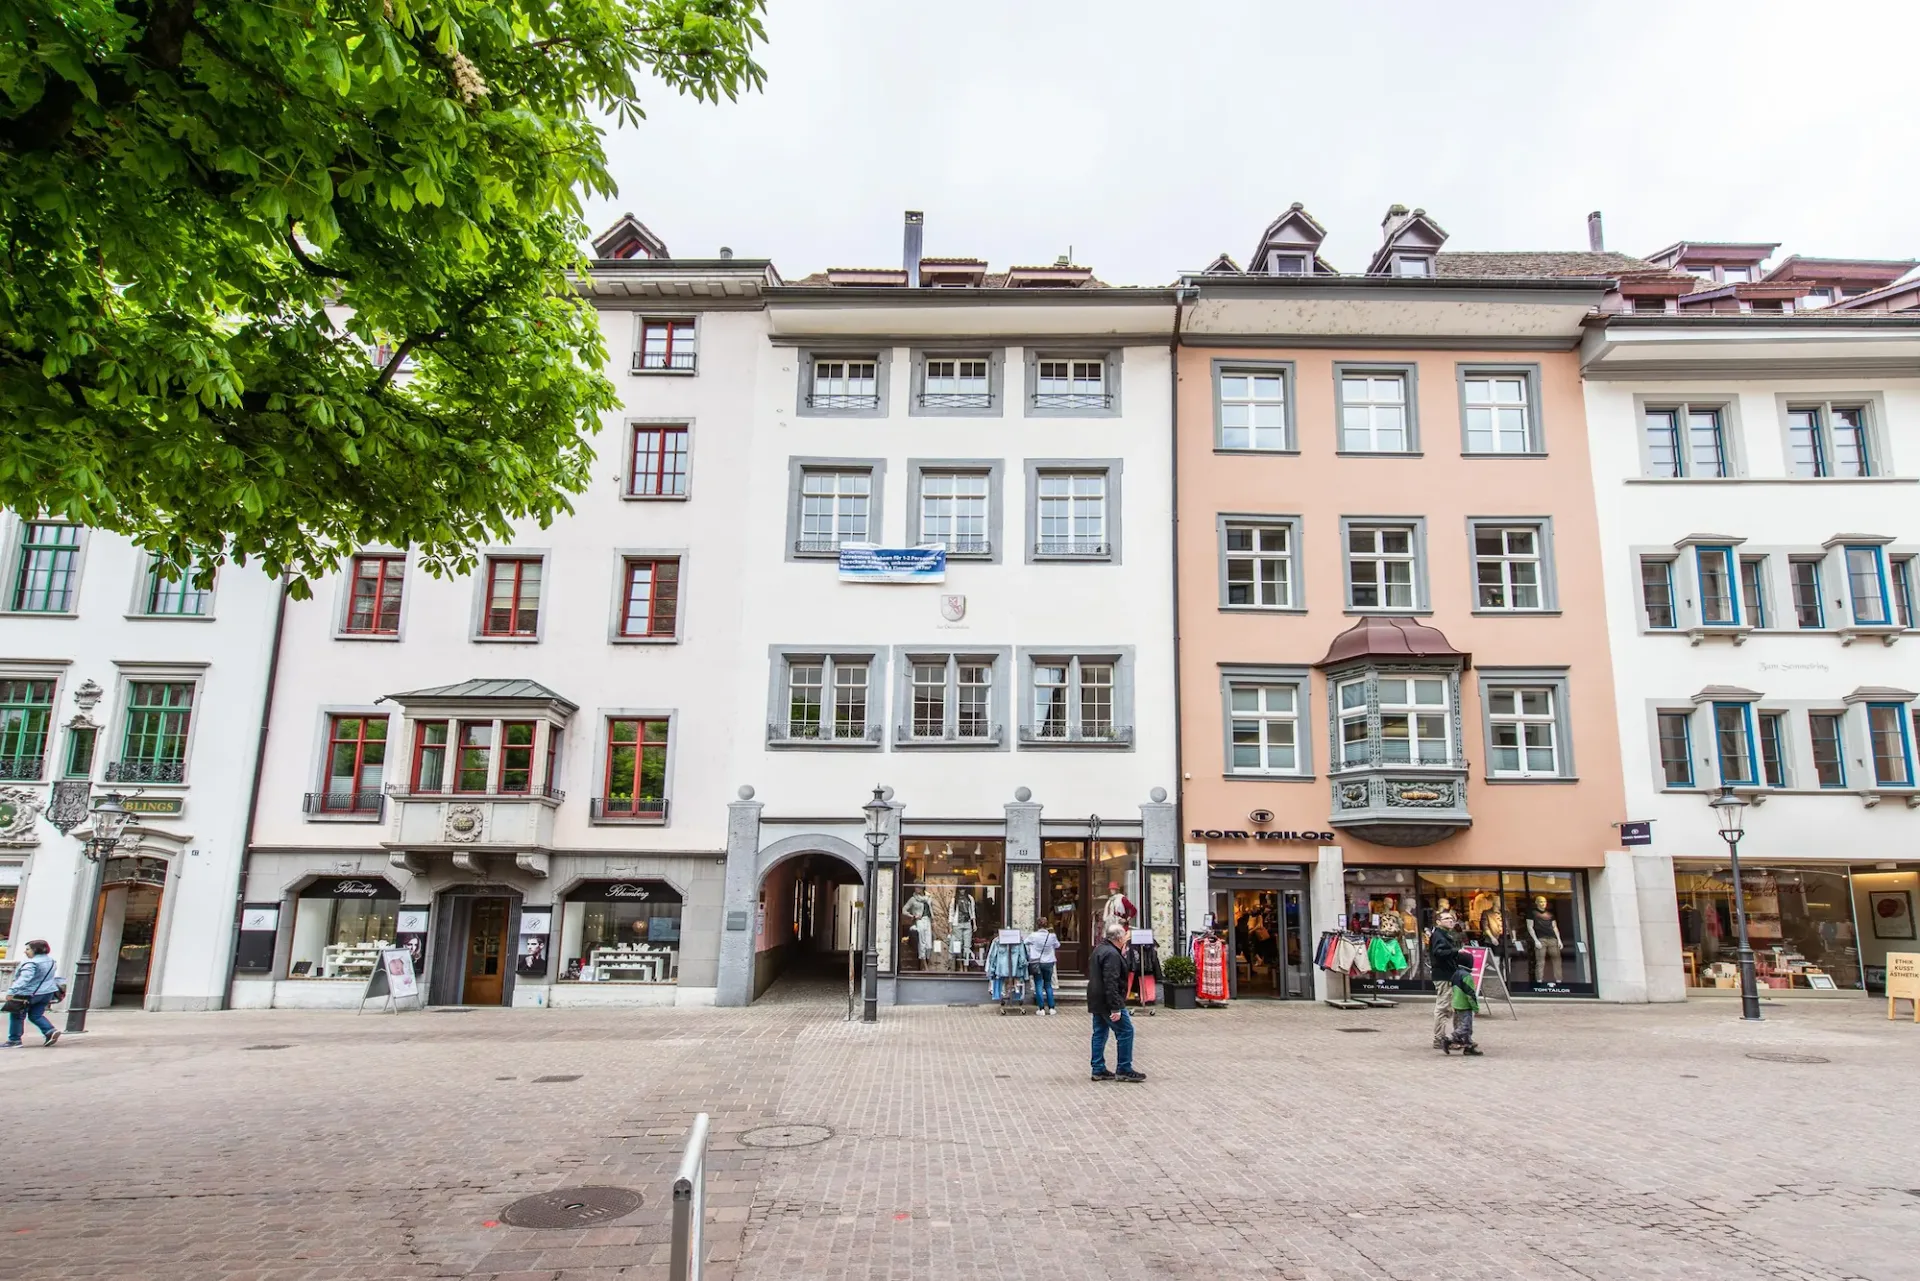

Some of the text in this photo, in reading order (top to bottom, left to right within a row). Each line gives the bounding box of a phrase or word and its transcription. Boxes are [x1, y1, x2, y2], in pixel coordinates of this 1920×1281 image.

[1191, 829, 1335, 842] TOM TAILOR
[333, 880, 378, 896] Rhomberg
[605, 884, 649, 900] Rhomberg
